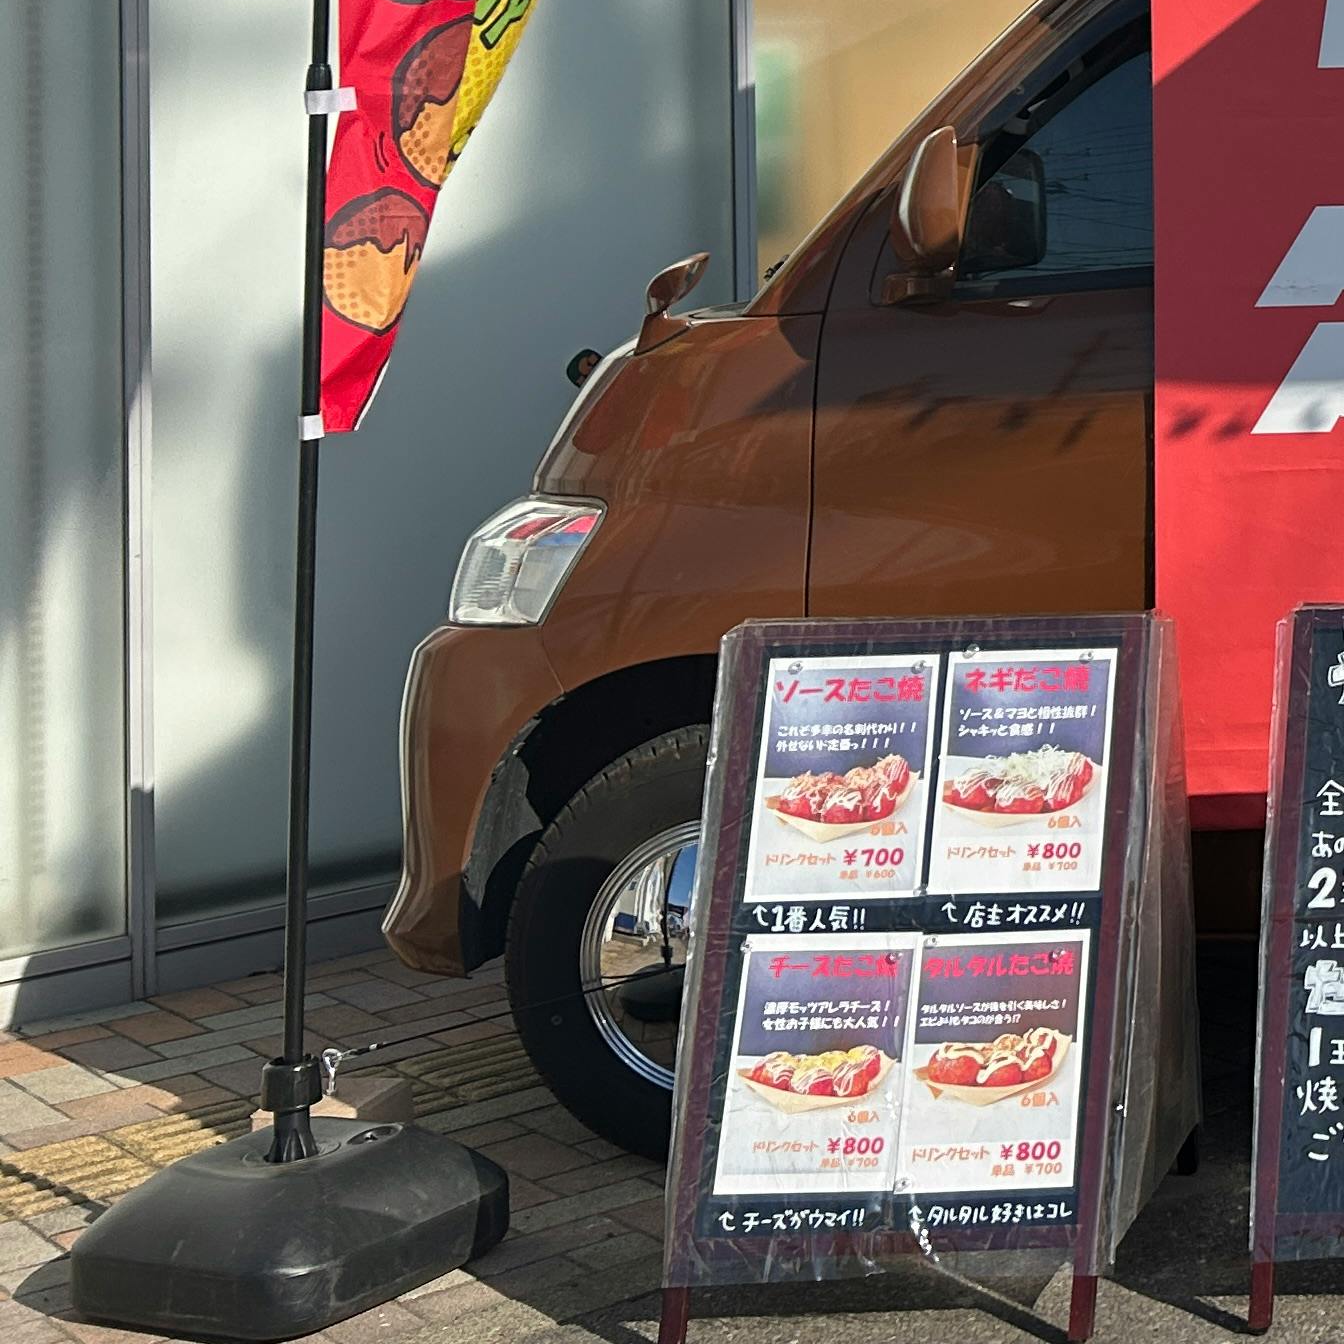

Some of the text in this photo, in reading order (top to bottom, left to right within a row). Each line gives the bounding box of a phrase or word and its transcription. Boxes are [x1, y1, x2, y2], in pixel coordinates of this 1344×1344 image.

[775, 676, 925, 704] ソースたこ焼
[1047, 816, 1081, 828] 6個入
[766, 848, 904, 867] ドリンクセット ¥700
[947, 843, 1081, 859] ドリンクセット ¥800
[865, 869, 896, 879] ¥600
[1023, 861, 1077, 871] 単品 ¥700
[771, 905, 866, 932] 1番人気!!
[925, 951, 1073, 979] タルタルたこ焼
[1021, 1092, 1060, 1107] 6個入
[848, 1110, 880, 1123] 6個入
[752, 1137, 884, 1155] ドリンクセット ¥800
[912, 1141, 1061, 1162] ドリンクセット ¥800
[847, 1158, 879, 1168] ¥700
[991, 1162, 1062, 1177] 単品 ¥700
[742, 1208, 865, 1233] チーズがウマイ!!
[927, 1202, 1073, 1225] タルタル好きはコレ
